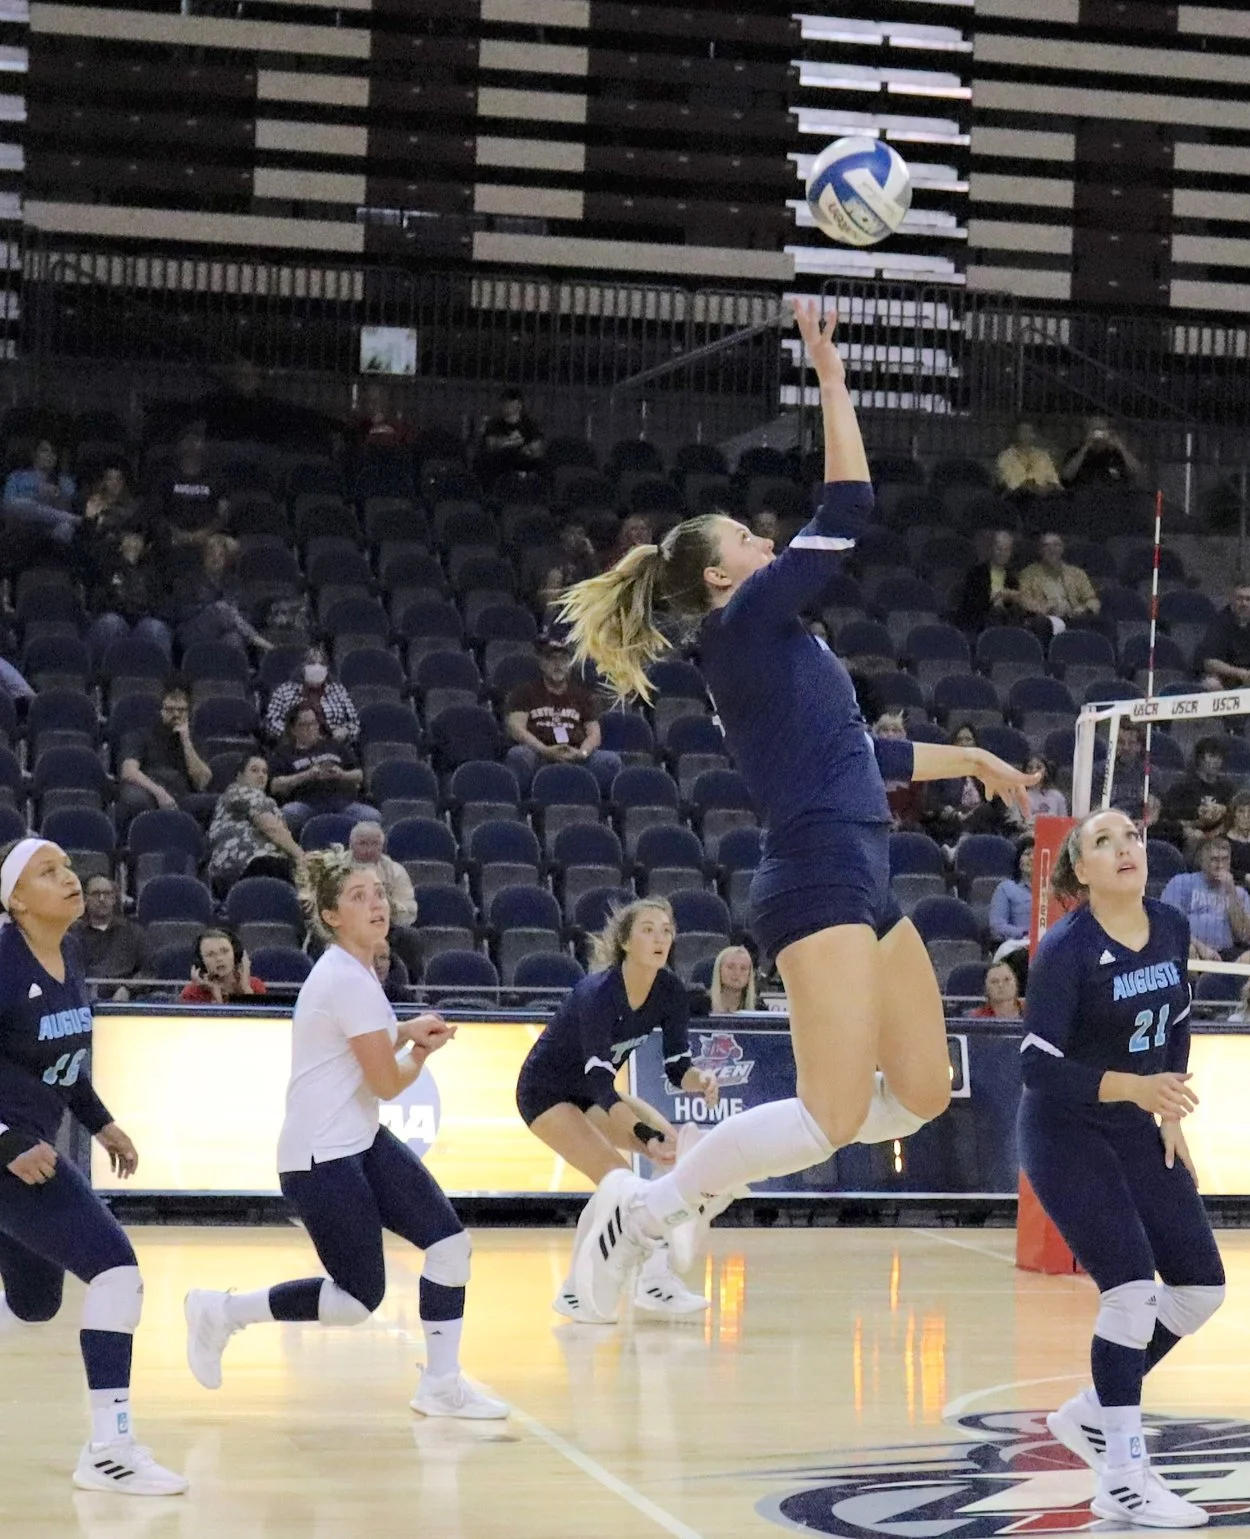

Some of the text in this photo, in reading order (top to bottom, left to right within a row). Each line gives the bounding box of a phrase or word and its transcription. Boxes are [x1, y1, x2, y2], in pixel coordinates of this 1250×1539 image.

[37, 1006, 93, 1041] AUGUS
[1128, 1003, 1170, 1053] 21
[378, 1104, 438, 1144] AA
[674, 1096, 744, 1122] HOME
